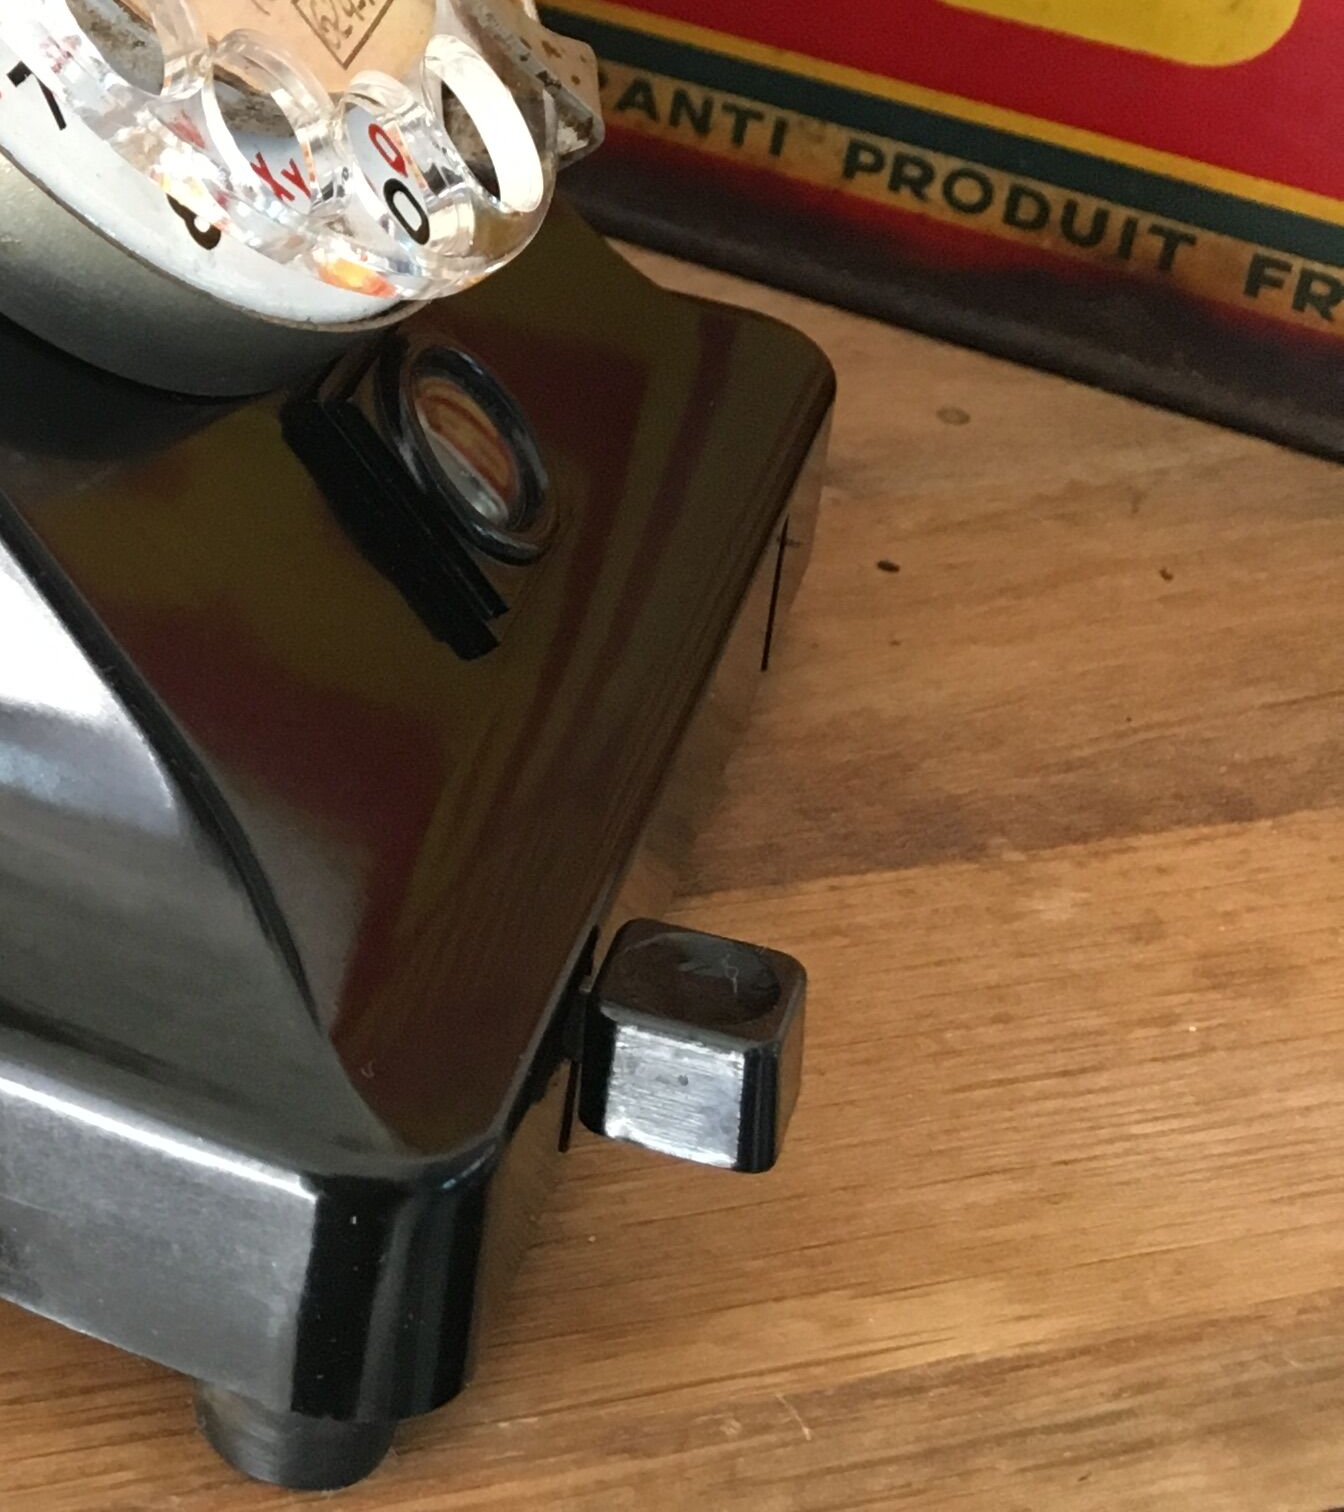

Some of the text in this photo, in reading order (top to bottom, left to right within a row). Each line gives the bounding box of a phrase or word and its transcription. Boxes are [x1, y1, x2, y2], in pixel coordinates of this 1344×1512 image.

[7, 60, 66, 131] 7
[600, 75, 1344, 322] ANTI PRODUIT FR
